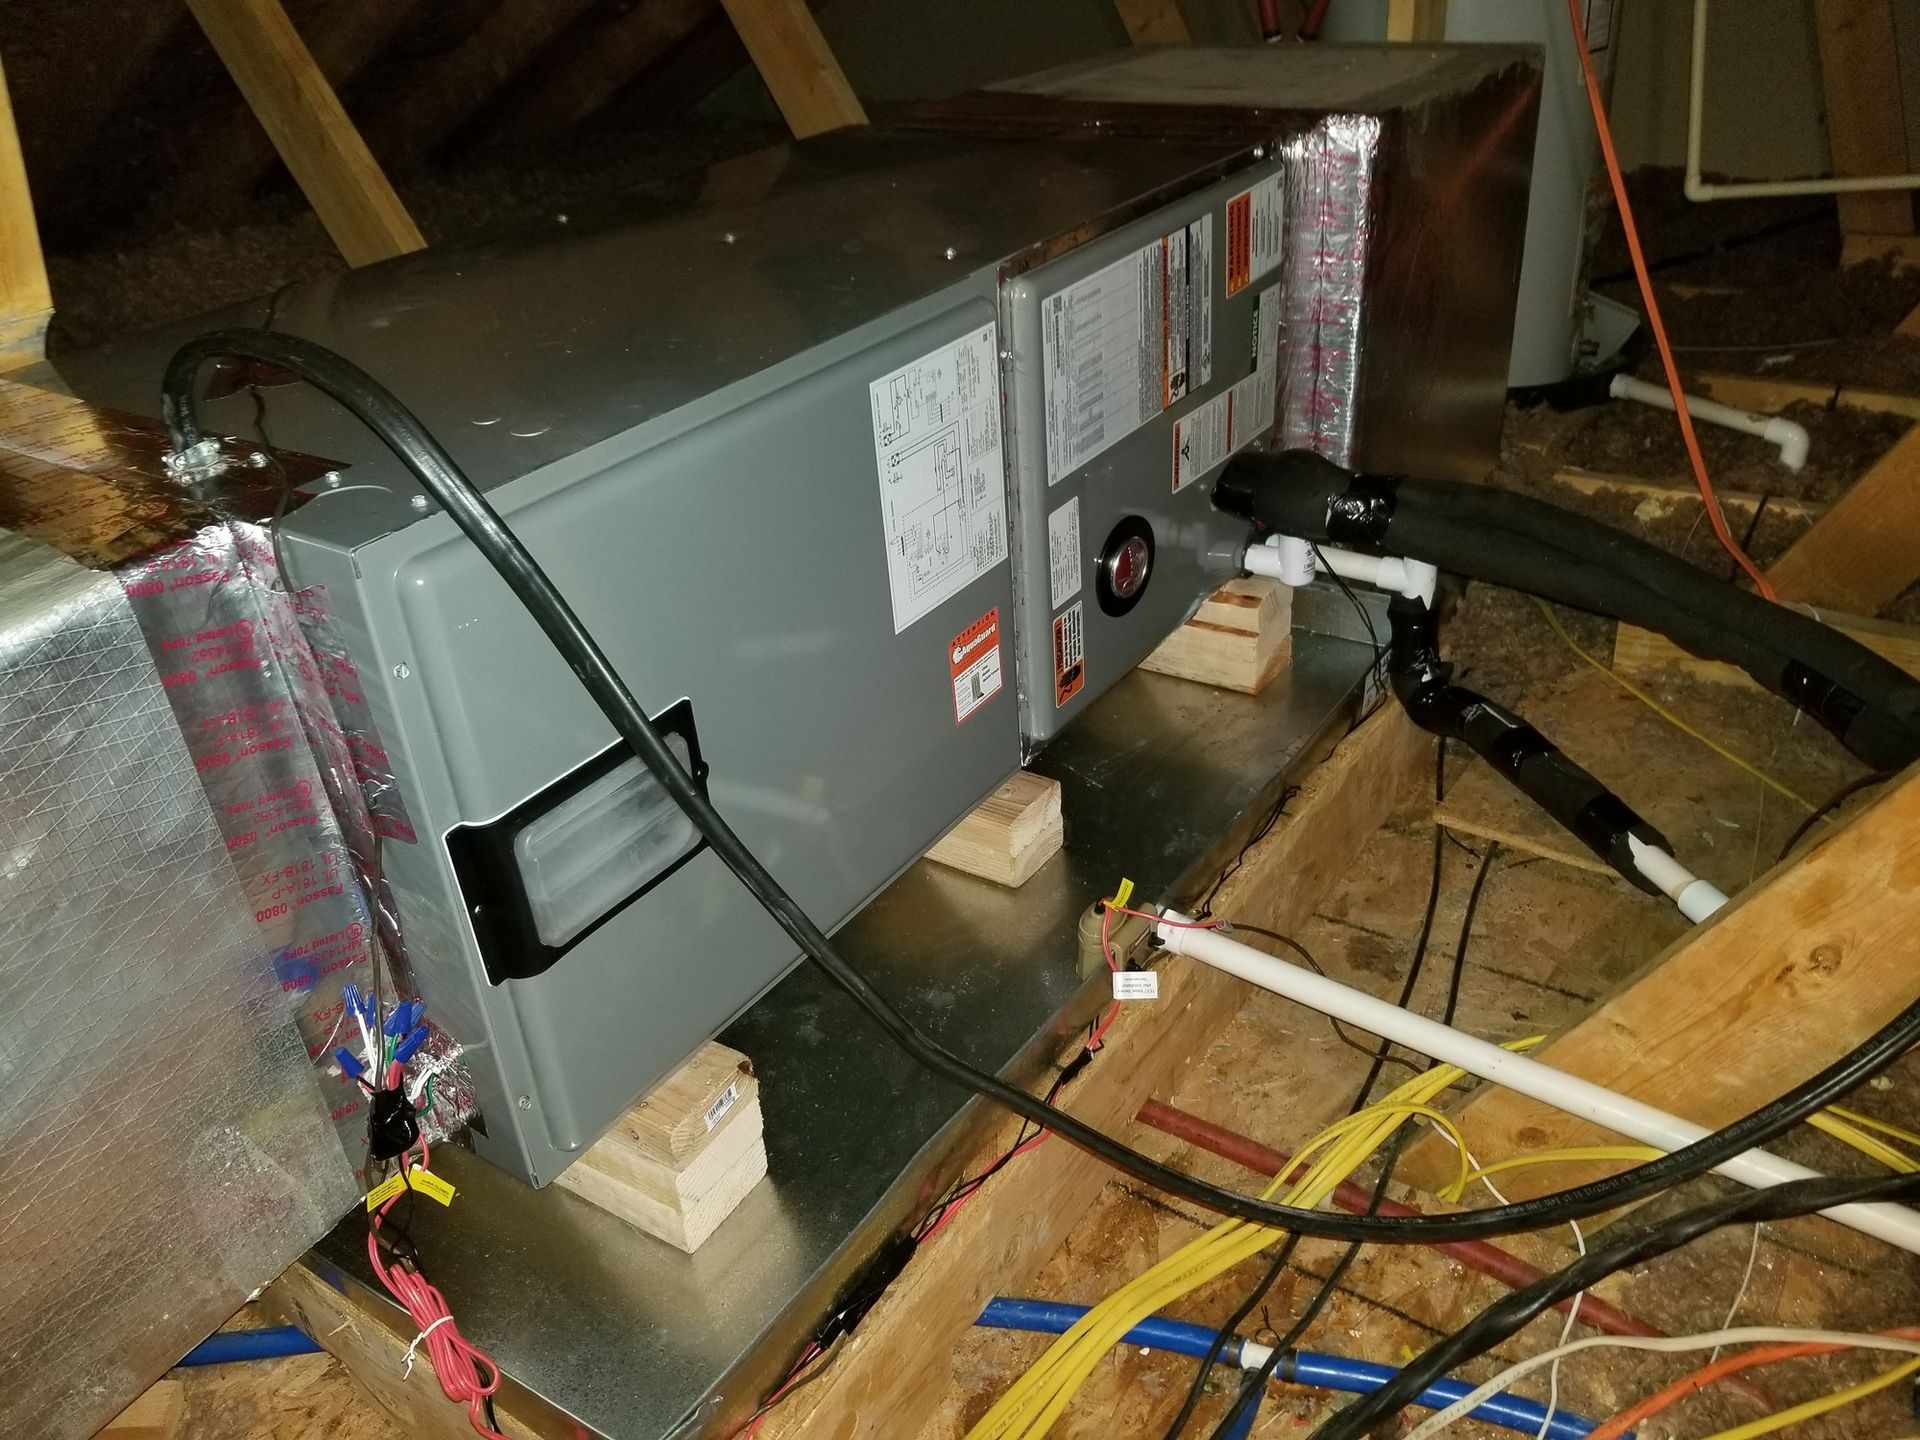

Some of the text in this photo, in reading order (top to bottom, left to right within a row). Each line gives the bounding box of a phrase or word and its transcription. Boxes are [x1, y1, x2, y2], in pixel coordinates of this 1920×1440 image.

[951, 610, 995, 647] ATTENTION
[269, 813, 318, 834] Fasson
[272, 868, 339, 900] UL 181A-P
[256, 883, 344, 922] Fasson 0800
[312, 932, 346, 950] Listed
[283, 974, 312, 992] 0800
[332, 1101, 359, 1120] 0800
